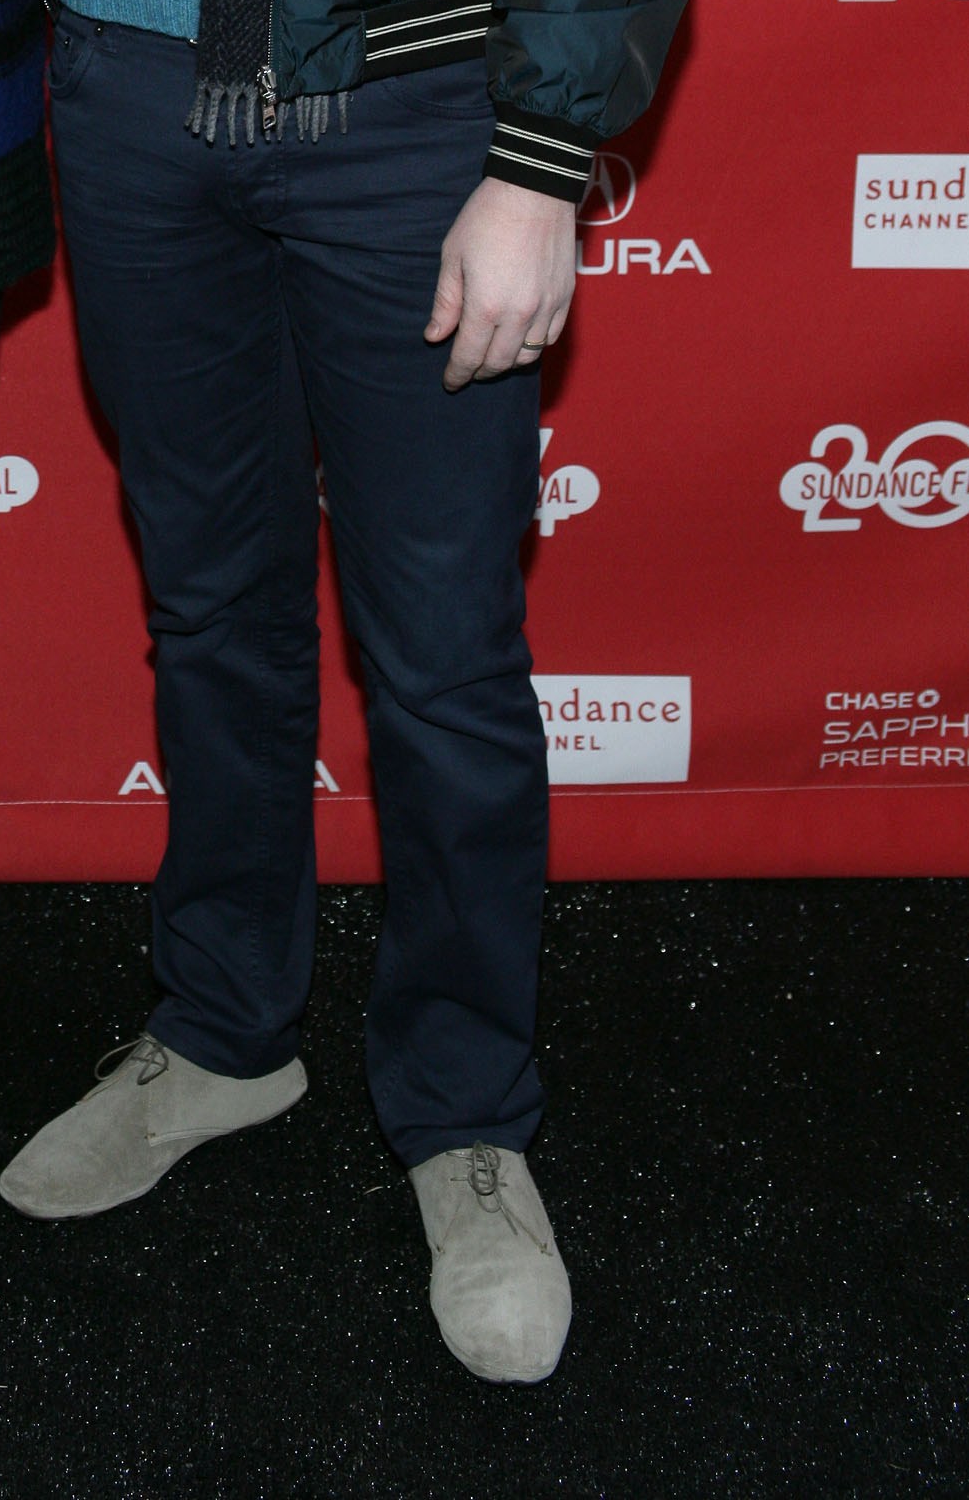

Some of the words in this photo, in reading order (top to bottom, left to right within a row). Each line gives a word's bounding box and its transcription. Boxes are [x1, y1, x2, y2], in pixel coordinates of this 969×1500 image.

[866, 166, 967, 200] sund
[864, 213, 969, 229] CHANNE
[576, 239, 712, 275] URA
[801, 471, 942, 500] SUNDANCE
[803, 420, 969, 531] 20
[538, 688, 680, 722] ndance
[825, 692, 915, 710] CHASE
[823, 713, 969, 744] SAPPH
[819, 746, 969, 769] PREFERR
